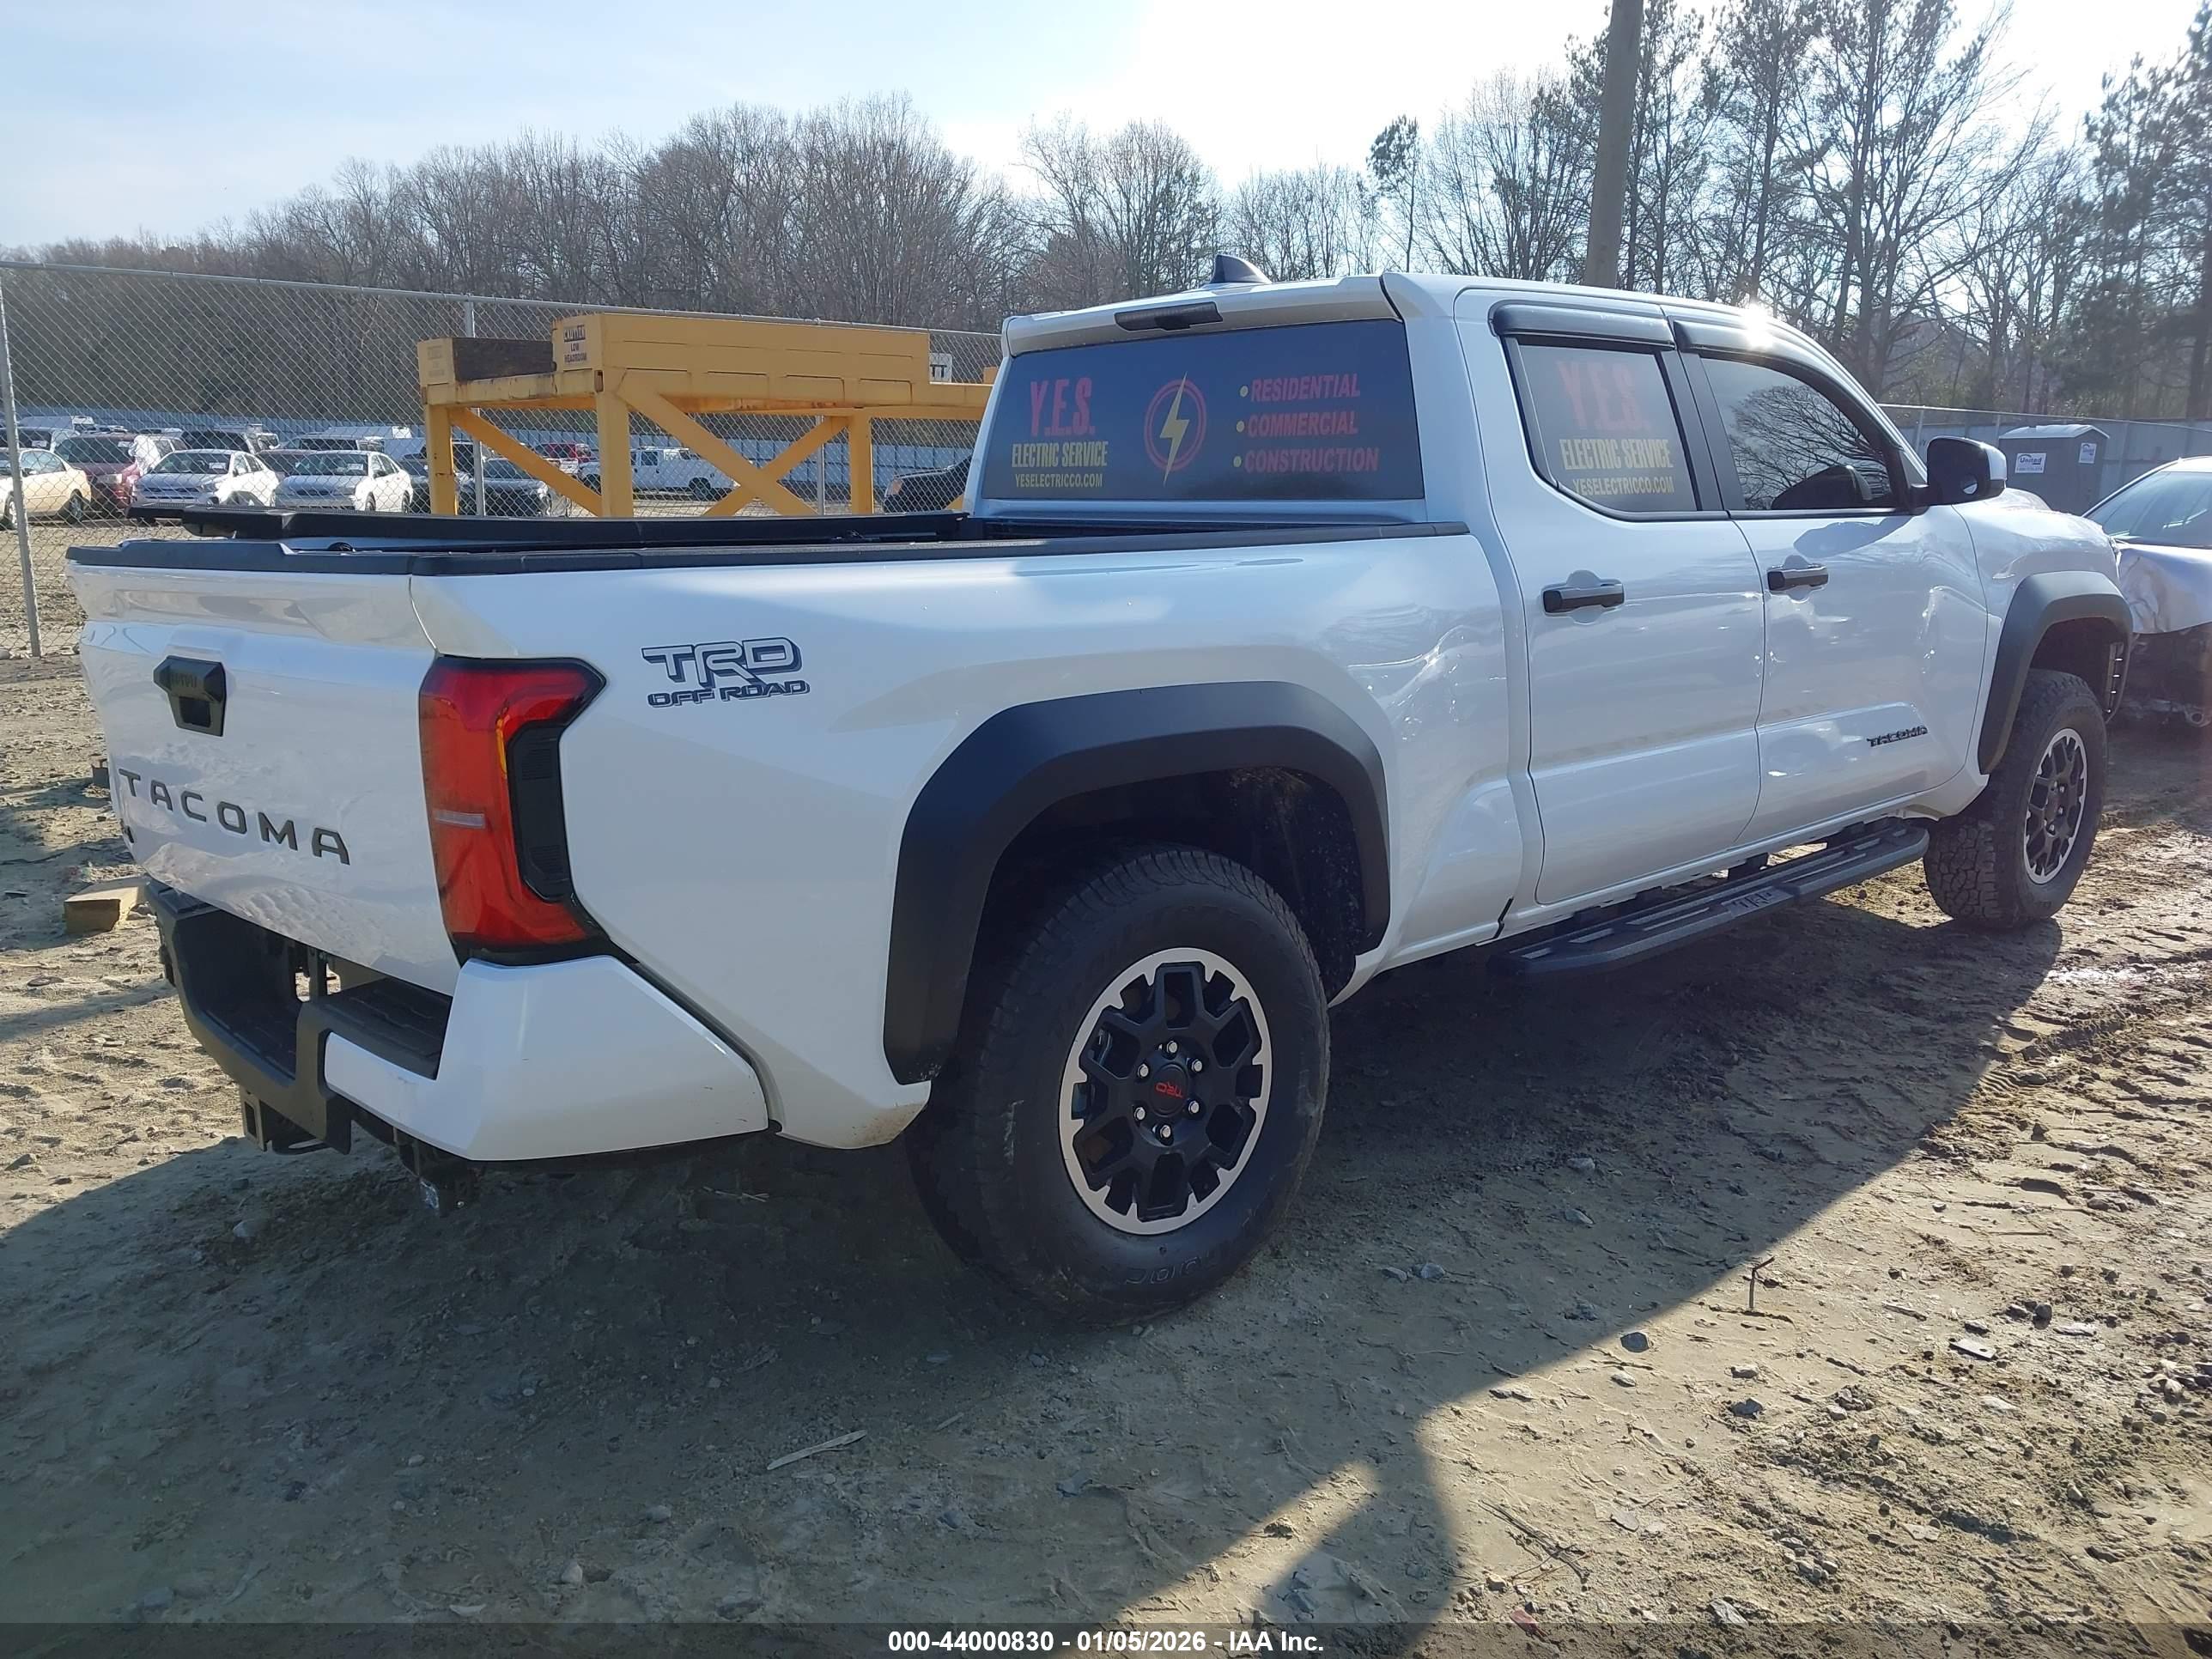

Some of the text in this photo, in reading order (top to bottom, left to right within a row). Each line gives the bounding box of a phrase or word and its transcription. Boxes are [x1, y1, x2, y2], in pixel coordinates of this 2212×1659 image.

[1250, 373, 1361, 403] RESIDENTIAL
[1030, 376, 1096, 437] Y.E.S.
[1247, 410, 1359, 438] COMMERCIAL
[1012, 441, 1109, 468] ELECTRIC SERVICE
[1244, 447, 1380, 473] CONSTRUCTION
[1559, 439, 1674, 471] ELECTRIC SERVICE
[1015, 472, 1103, 488] YESELECTRICCO.COM
[1572, 476, 1674, 495] YESELECTRICCO.COM
[641, 636, 803, 689] TRD
[647, 680, 811, 708] OFF ROAD
[118, 769, 350, 866] TACOMA
